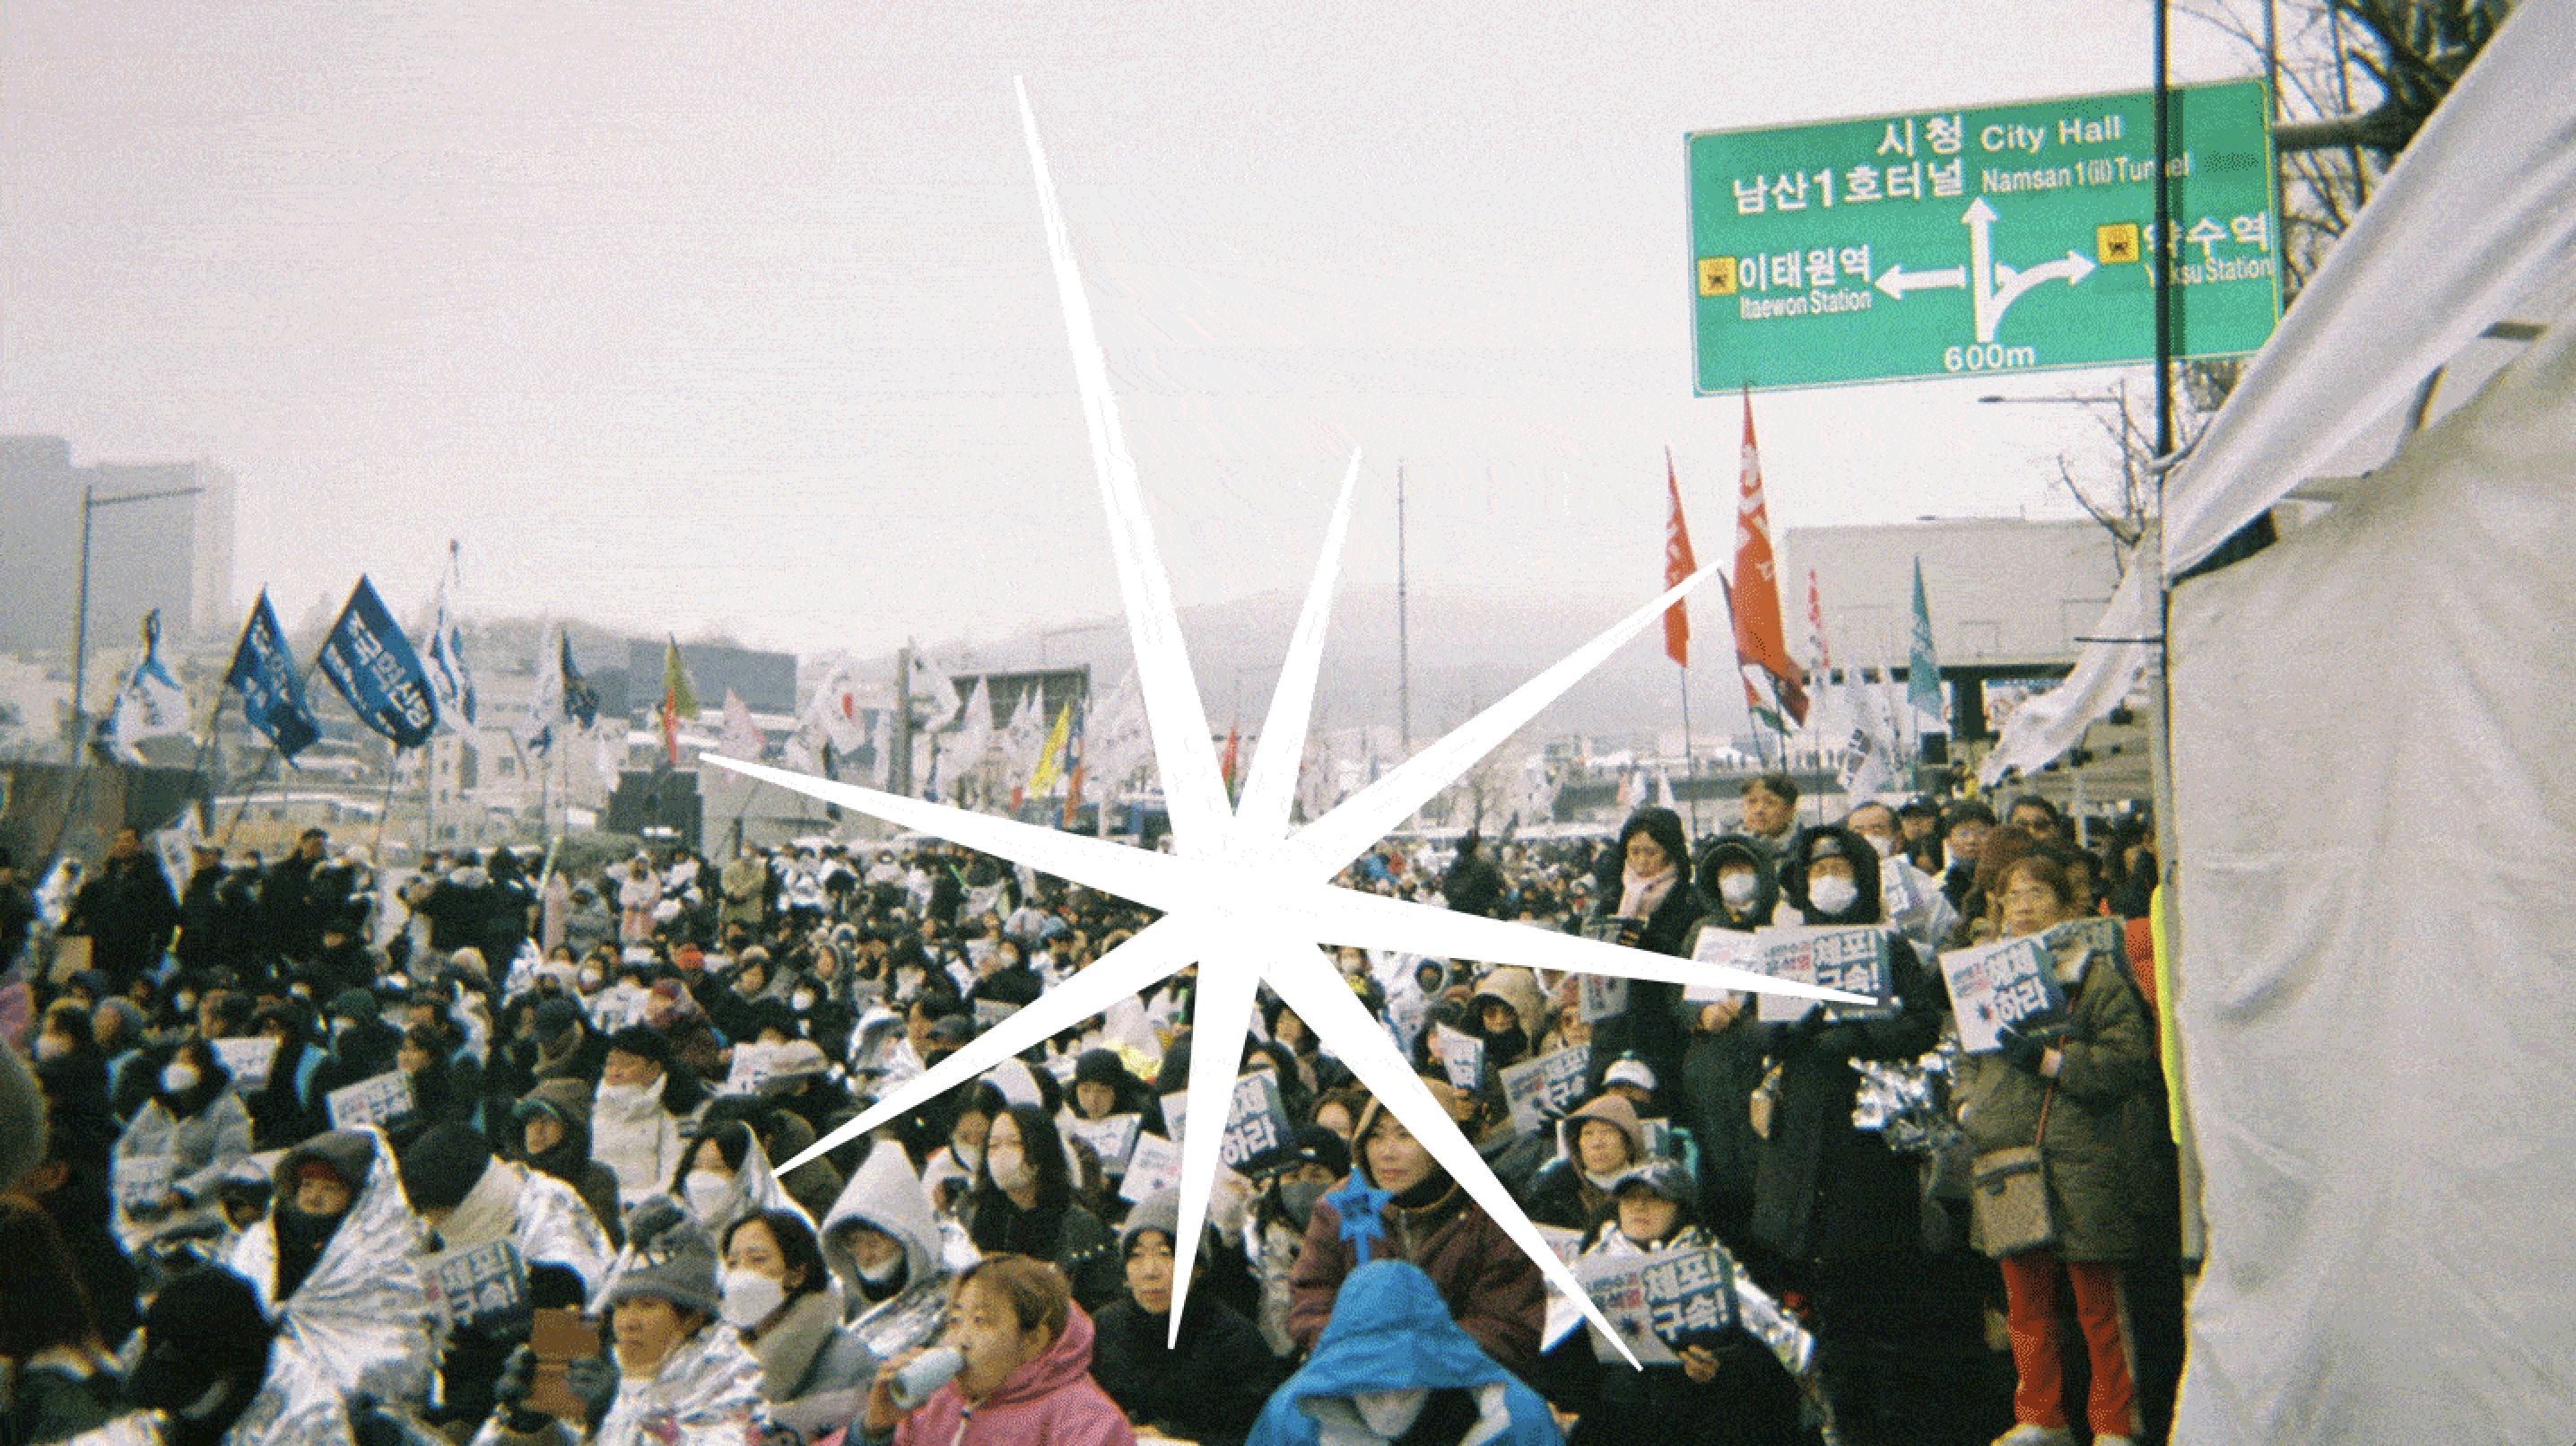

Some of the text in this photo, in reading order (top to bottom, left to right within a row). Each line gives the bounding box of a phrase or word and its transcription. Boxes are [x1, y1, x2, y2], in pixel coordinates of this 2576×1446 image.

[1876, 115, 1963, 158] 시청
[1980, 115, 2121, 154] City Hall
[1980, 165, 2071, 194] Namsan
[1738, 244, 1871, 293] 이태원역
[1740, 287, 1872, 320] Itaewon Station
[1943, 343, 2036, 372] 600m
[1653, 1287, 1728, 1343] 구속!
